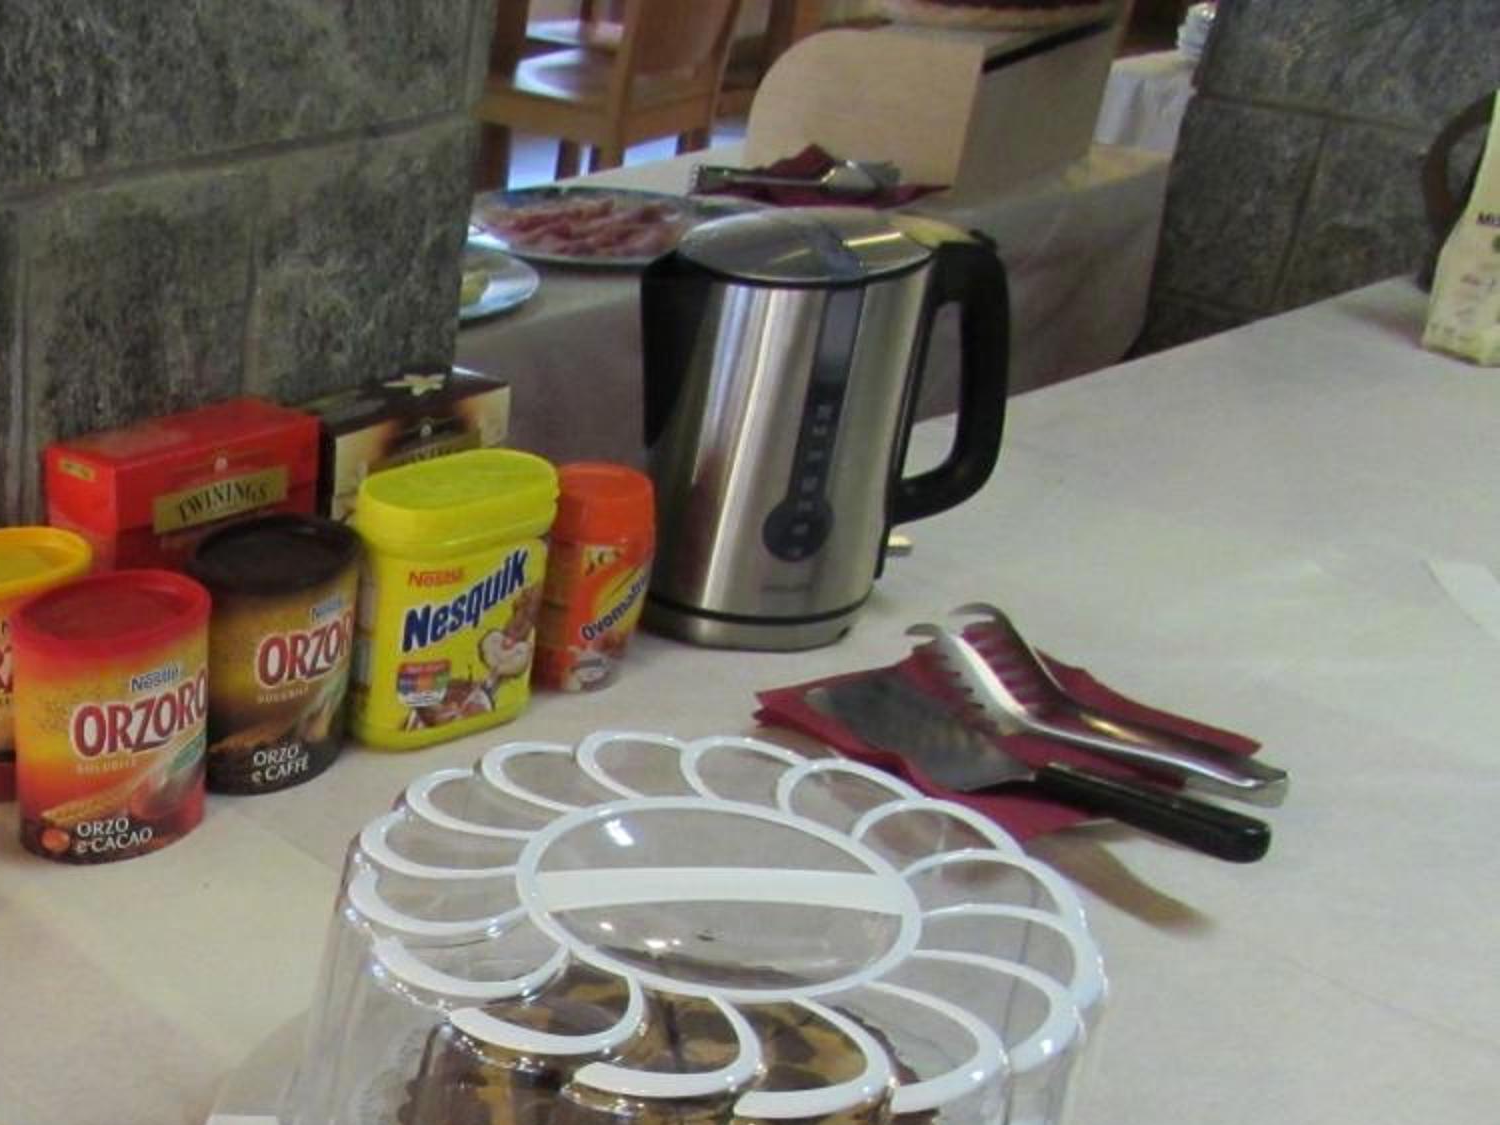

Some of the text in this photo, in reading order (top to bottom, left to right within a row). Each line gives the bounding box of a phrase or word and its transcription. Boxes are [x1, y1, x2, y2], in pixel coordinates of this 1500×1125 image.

[179, 480, 269, 523] TWININGS
[403, 549, 528, 652] Nesquik
[253, 743, 300, 767] ORZO
[76, 816, 130, 838] ORZO
[91, 826, 154, 853] CACAO
